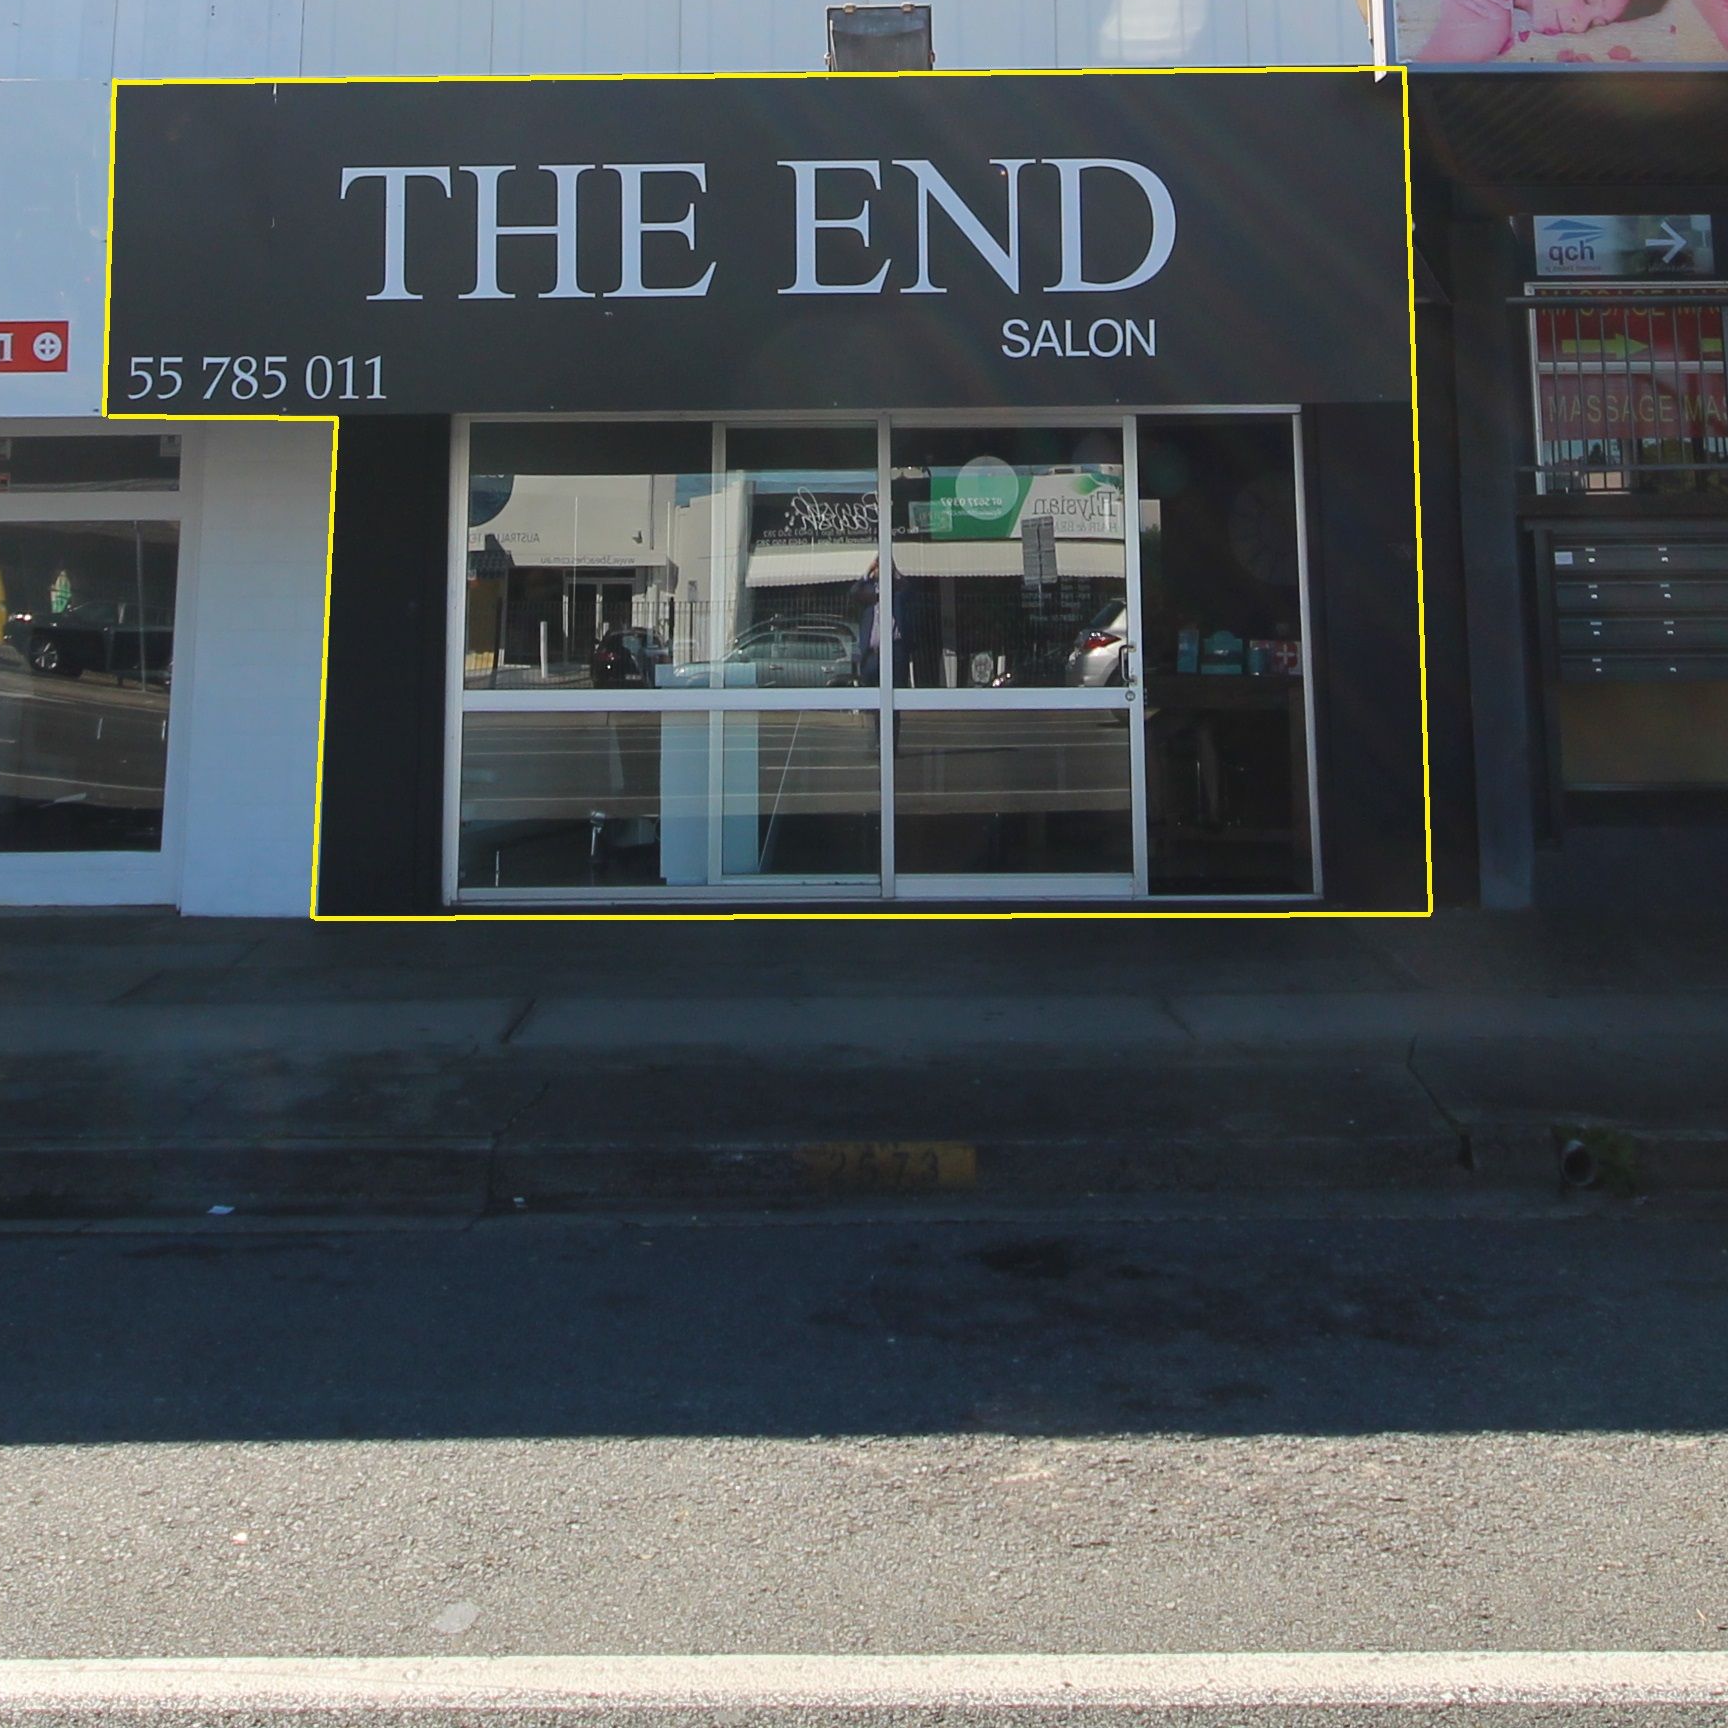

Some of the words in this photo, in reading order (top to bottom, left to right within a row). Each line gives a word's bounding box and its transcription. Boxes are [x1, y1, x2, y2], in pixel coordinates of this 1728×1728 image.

[340, 162, 717, 302] THE
[776, 158, 1176, 295] END
[1548, 239, 1595, 265] qch
[1001, 318, 1156, 359] SALON
[127, 356, 183, 400] 55
[202, 355, 287, 400] 785
[305, 355, 387, 400] 011
[1547, 395, 1675, 423] MASSAGE
